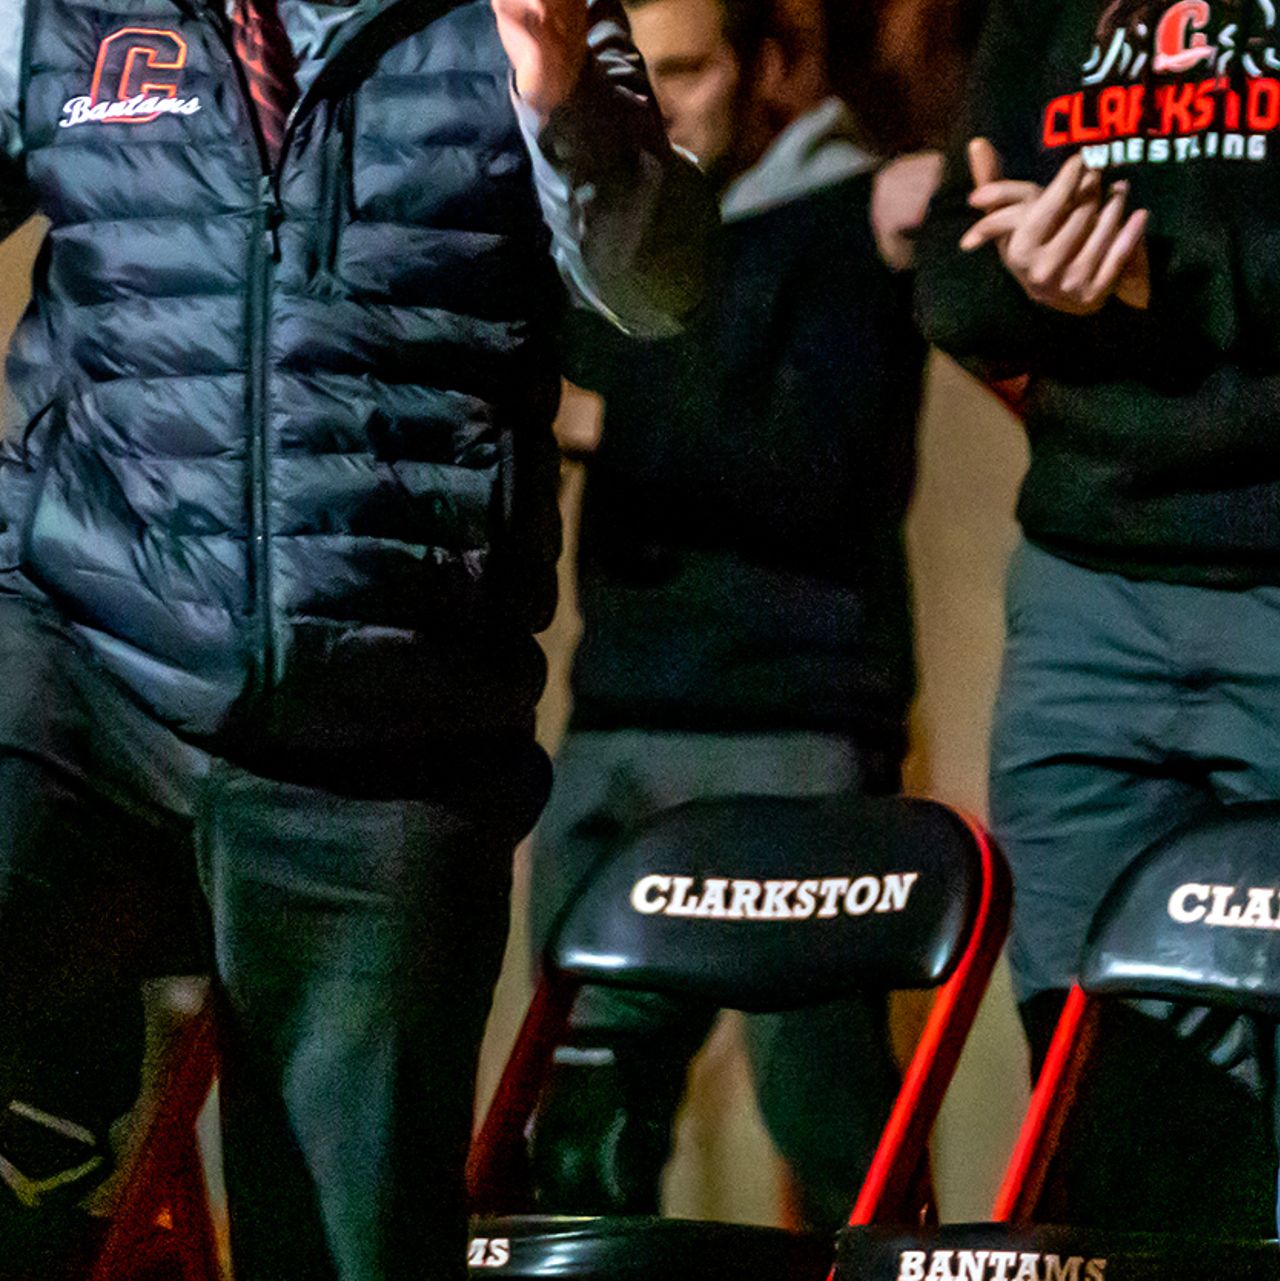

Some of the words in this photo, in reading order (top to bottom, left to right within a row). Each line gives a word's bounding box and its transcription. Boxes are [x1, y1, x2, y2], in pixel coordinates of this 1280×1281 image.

[90, 27, 188, 123] C
[58, 93, 202, 128] Bantams
[630, 872, 919, 920] CLARKSTON
[896, 1250, 1108, 1281] BANTAMS
